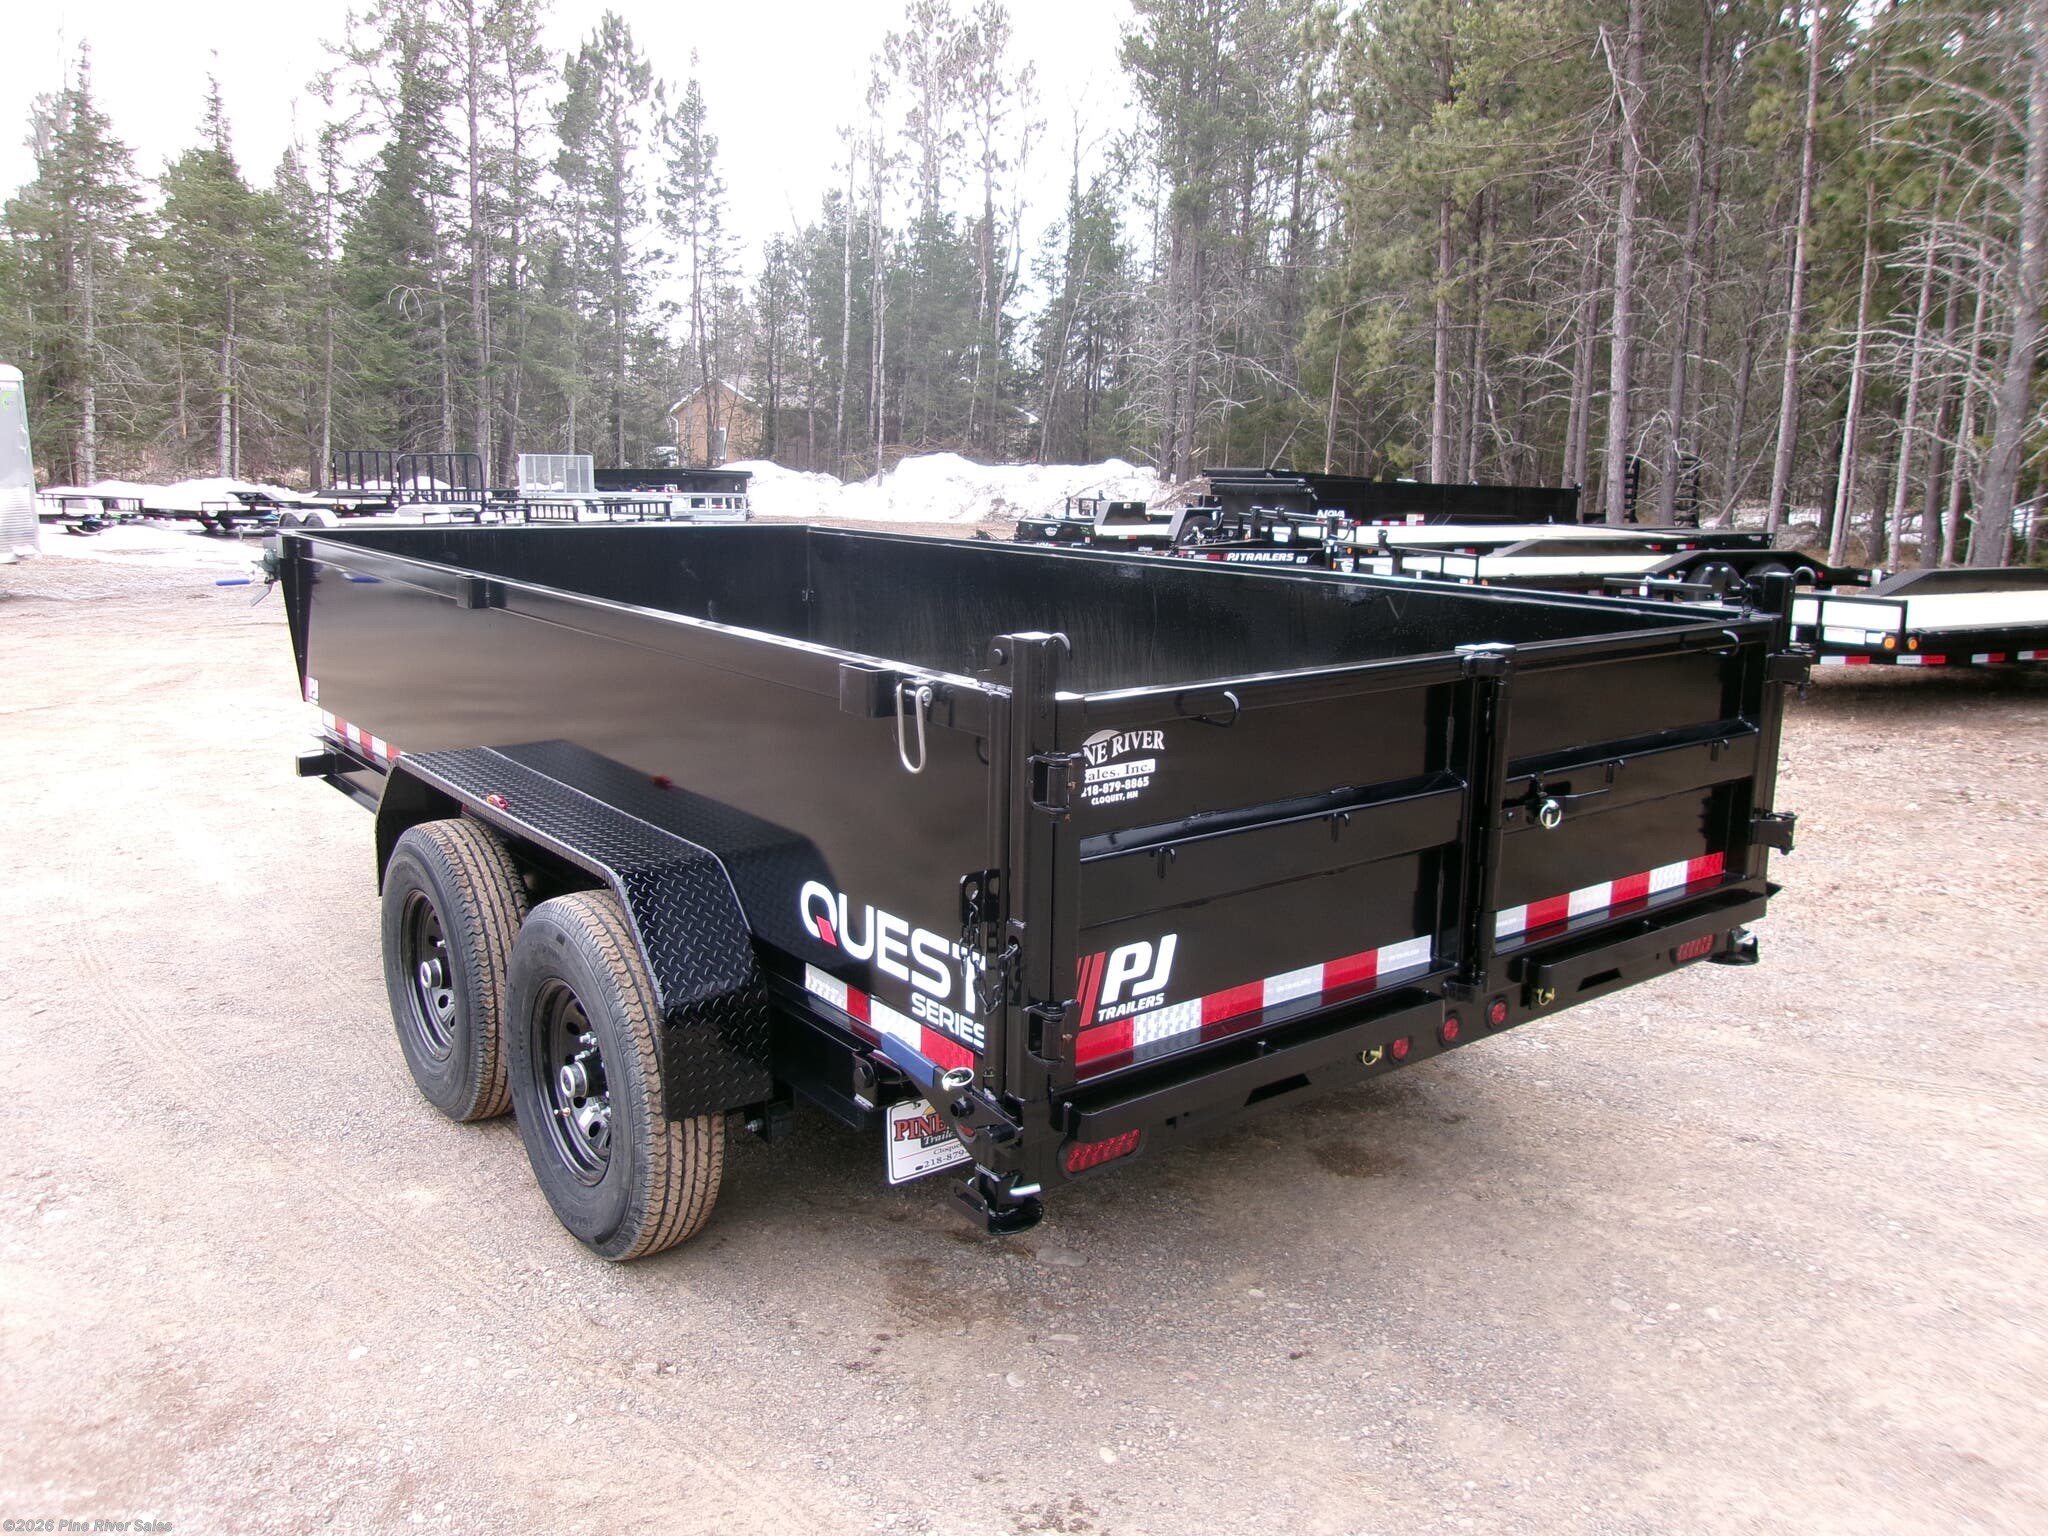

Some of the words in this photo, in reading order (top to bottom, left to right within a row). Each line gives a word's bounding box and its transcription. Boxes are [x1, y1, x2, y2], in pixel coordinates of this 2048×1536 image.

[1240, 552, 1295, 562] TRAILERS
[1111, 730, 1165, 758] RIVER
[1124, 763, 1152, 775] Inc.
[1091, 792, 1126, 806] CLOQUET,
[1126, 790, 1139, 800] MN
[800, 880, 986, 1014] QUEST
[1100, 933, 1177, 1005] PJ
[911, 991, 985, 1049] SERIES
[1098, 993, 1165, 1022] TRAILERS
